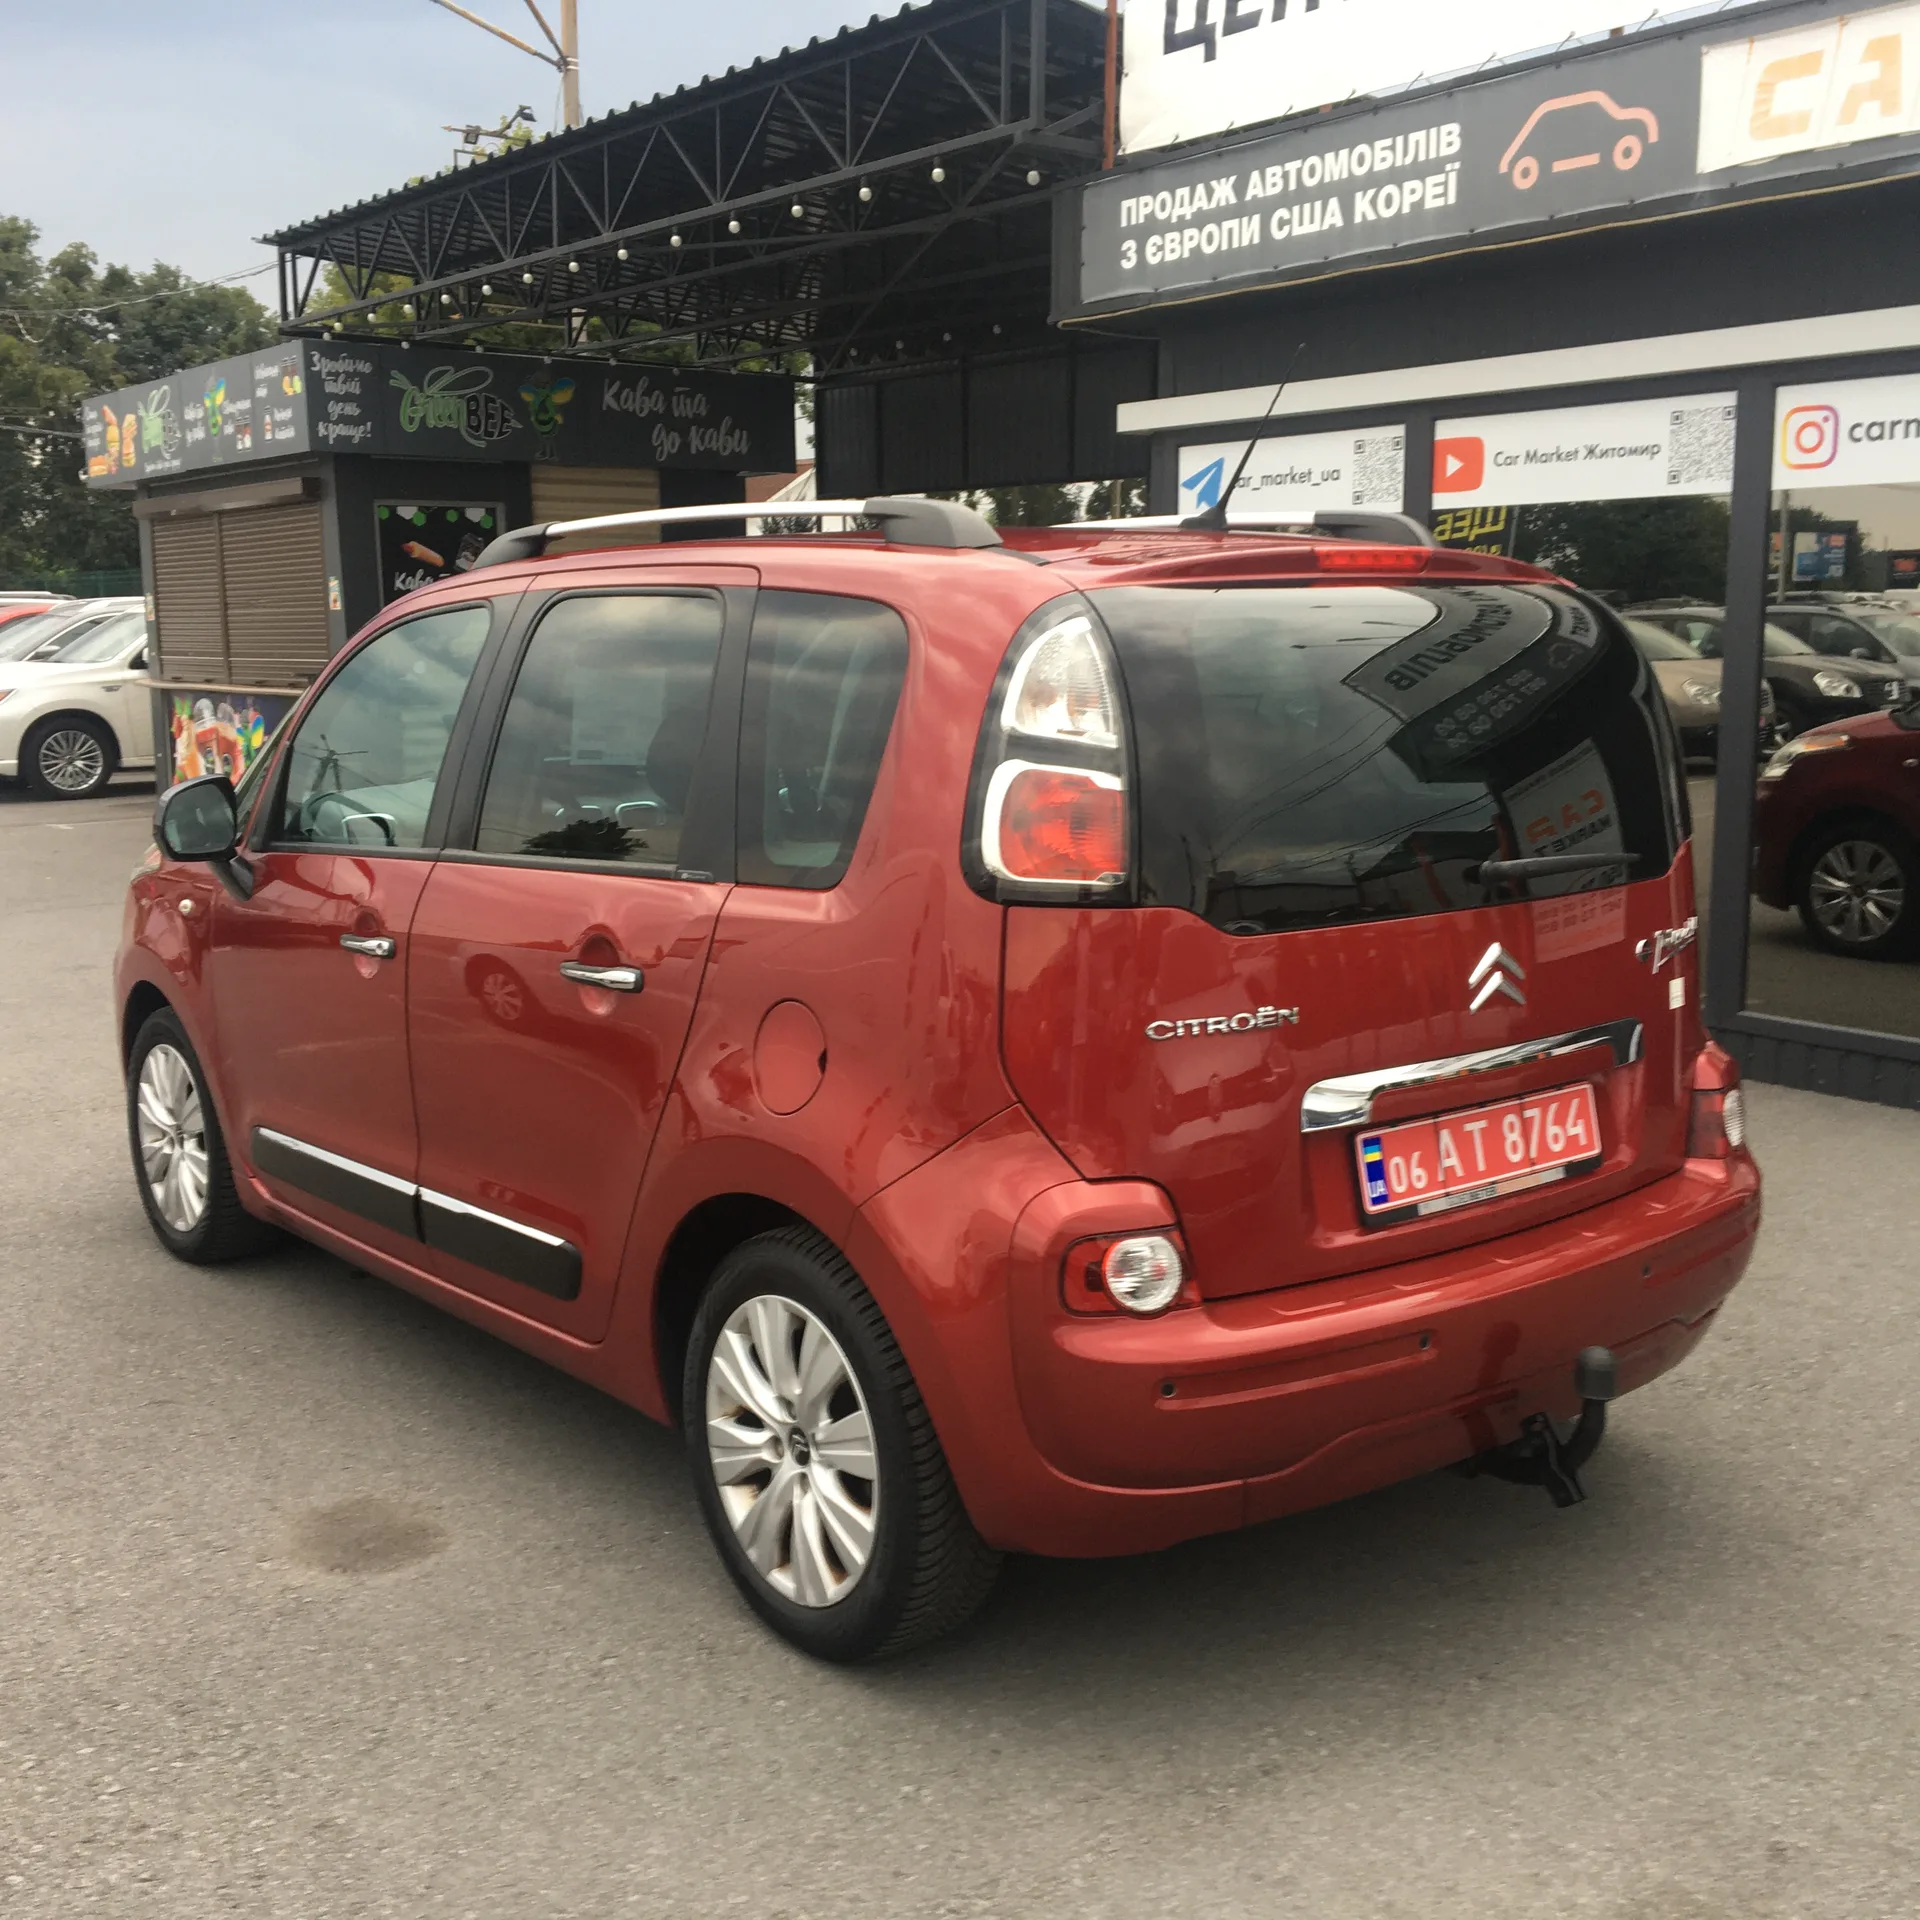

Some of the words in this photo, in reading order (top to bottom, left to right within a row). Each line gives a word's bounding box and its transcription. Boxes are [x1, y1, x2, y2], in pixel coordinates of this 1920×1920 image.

[1120, 174, 1237, 228] ПРОДАЖ
[1245, 122, 1462, 201] АВТОМОБІЛІВ
[1120, 239, 1137, 269] З
[1145, 213, 1261, 266] ЄВРОПИ
[1270, 198, 1344, 241] США
[1354, 162, 1461, 224] КОРЕЇ
[602, 376, 667, 417] Кава
[672, 386, 710, 418] та
[651, 423, 682, 461] до
[688, 416, 751, 456] кави
[1493, 451, 1520, 467] Car
[1524, 445, 1580, 465] Market
[1583, 443, 1662, 461] Житомир
[1235, 466, 1341, 491] ar_market_ua
[1144, 1005, 1300, 1040] CITROËN
[1389, 1150, 1429, 1194] 06
[1438, 1119, 1489, 1182] AT
[1502, 1097, 1588, 1163] 8764
[1367, 1179, 1388, 1198] UA
